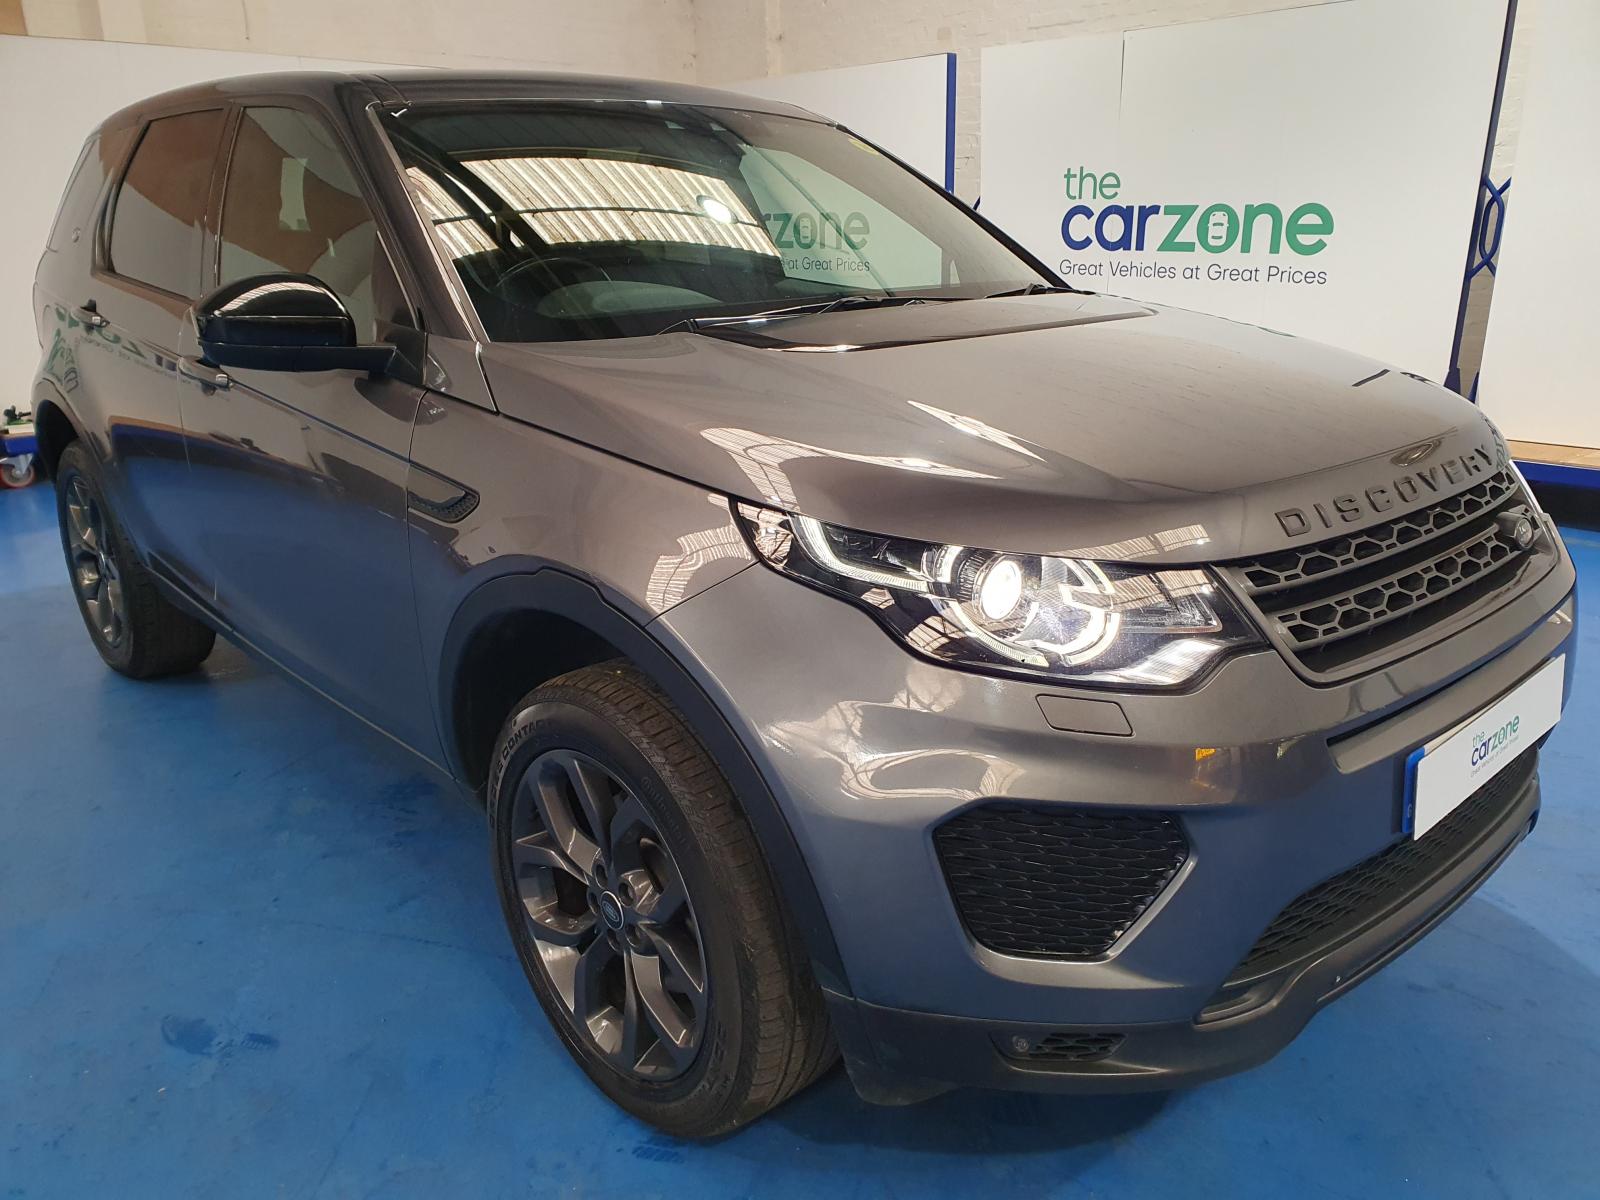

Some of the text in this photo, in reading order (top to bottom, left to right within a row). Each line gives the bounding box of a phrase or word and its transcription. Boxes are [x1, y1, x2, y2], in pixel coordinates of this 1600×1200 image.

[1064, 166, 1121, 200] the
[1061, 202, 1335, 256] carzone
[801, 257, 832, 271] Great
[836, 258, 870, 272] Prices
[1059, 259, 1328, 285] Great Vehicles at Great Prices
[1275, 445, 1493, 537] DISCOVERY
[1471, 715, 1520, 767] carzone
[1472, 731, 1485, 747] the
